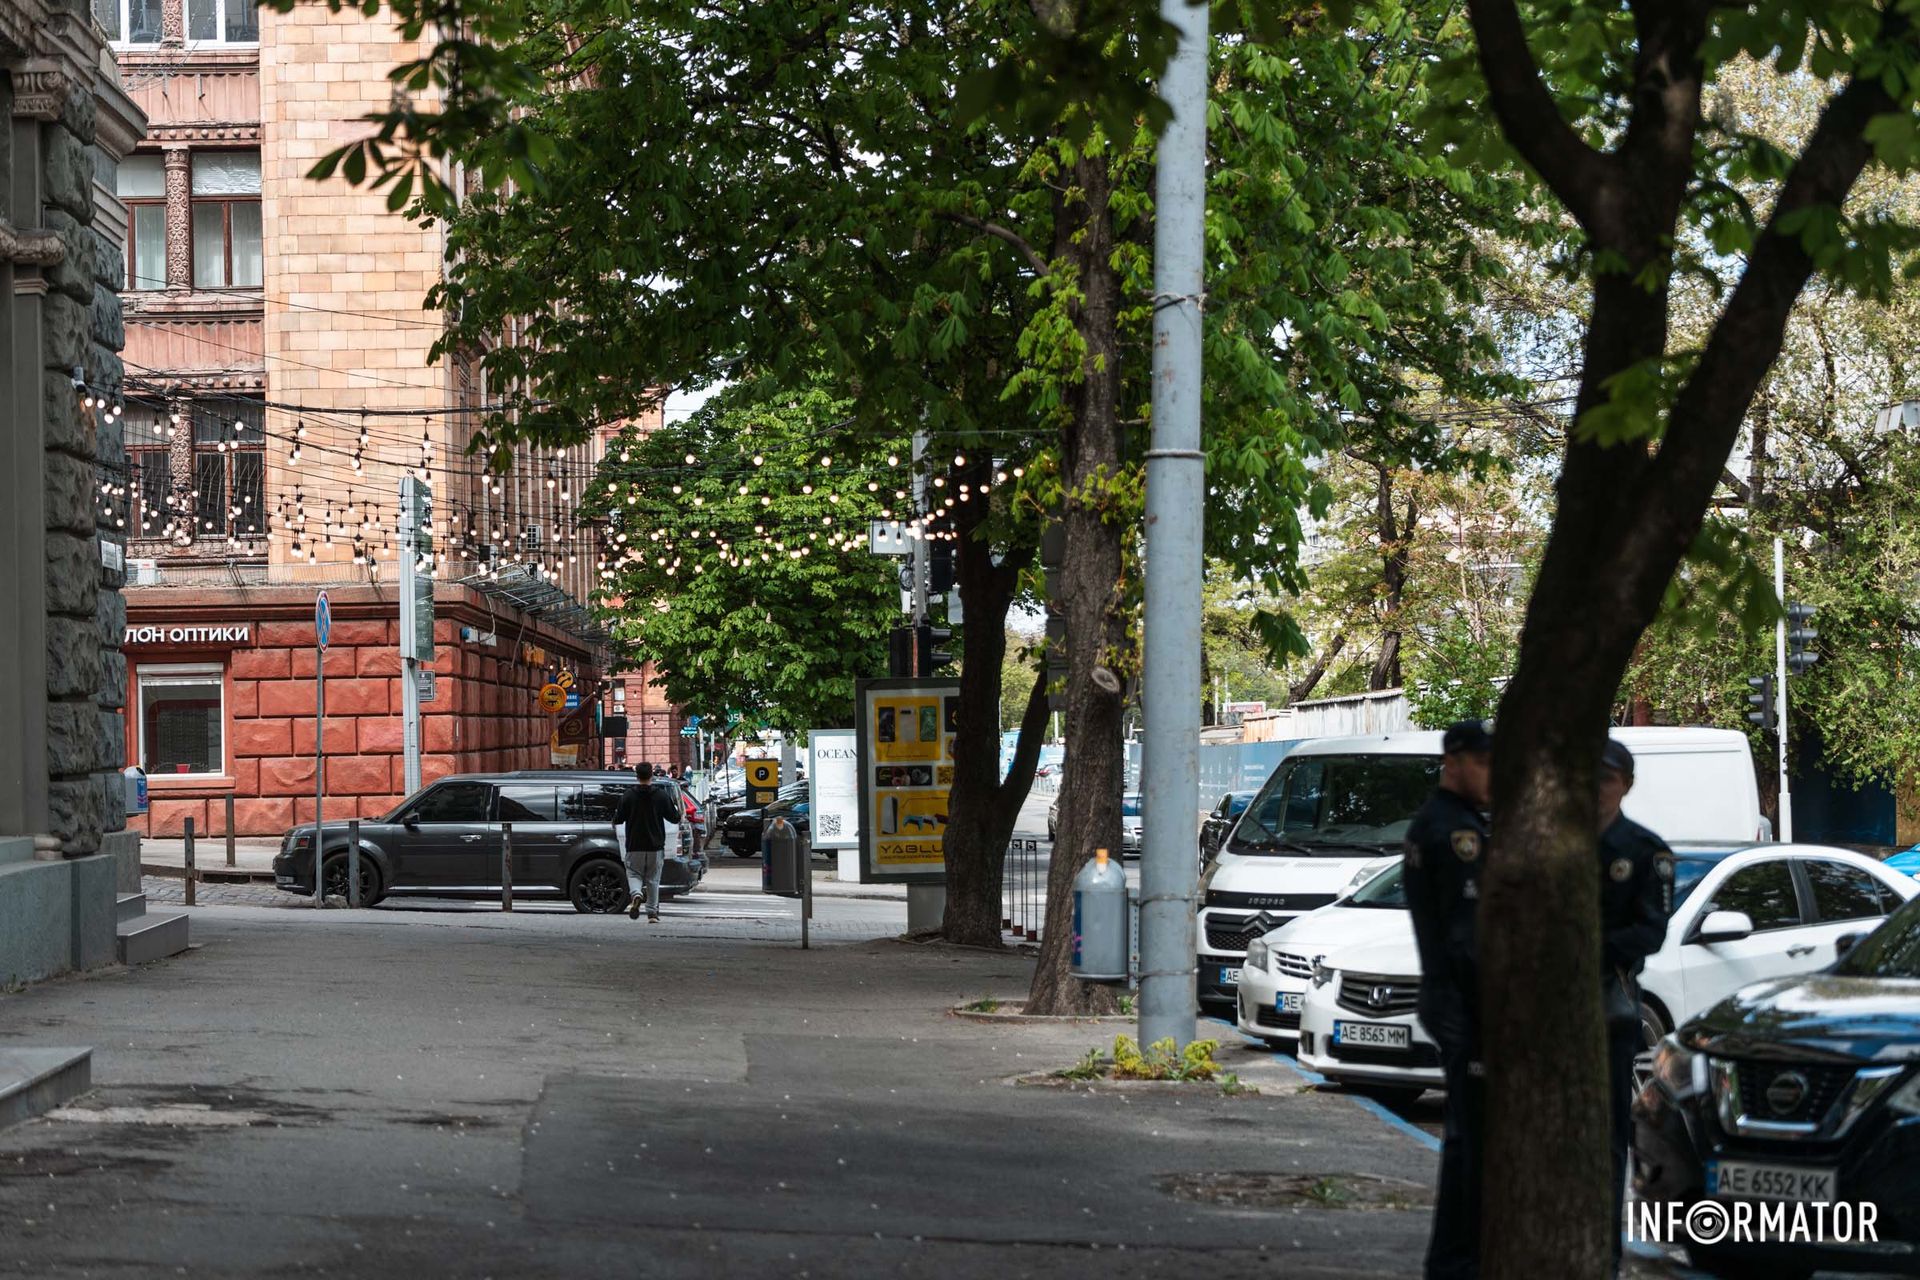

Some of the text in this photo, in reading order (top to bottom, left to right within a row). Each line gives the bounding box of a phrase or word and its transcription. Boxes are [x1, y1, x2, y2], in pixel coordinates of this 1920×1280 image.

[169, 627, 249, 642] ОПТИКИ
[817, 749, 858, 759] OCEAN
[758, 769, 766, 778] P
[1226, 970, 1239, 982] AE
[1282, 995, 1299, 1009] AE
[1341, 1025, 1406, 1045] AE 8565 MM
[1718, 1167, 1830, 1200] AE 6552 KK
